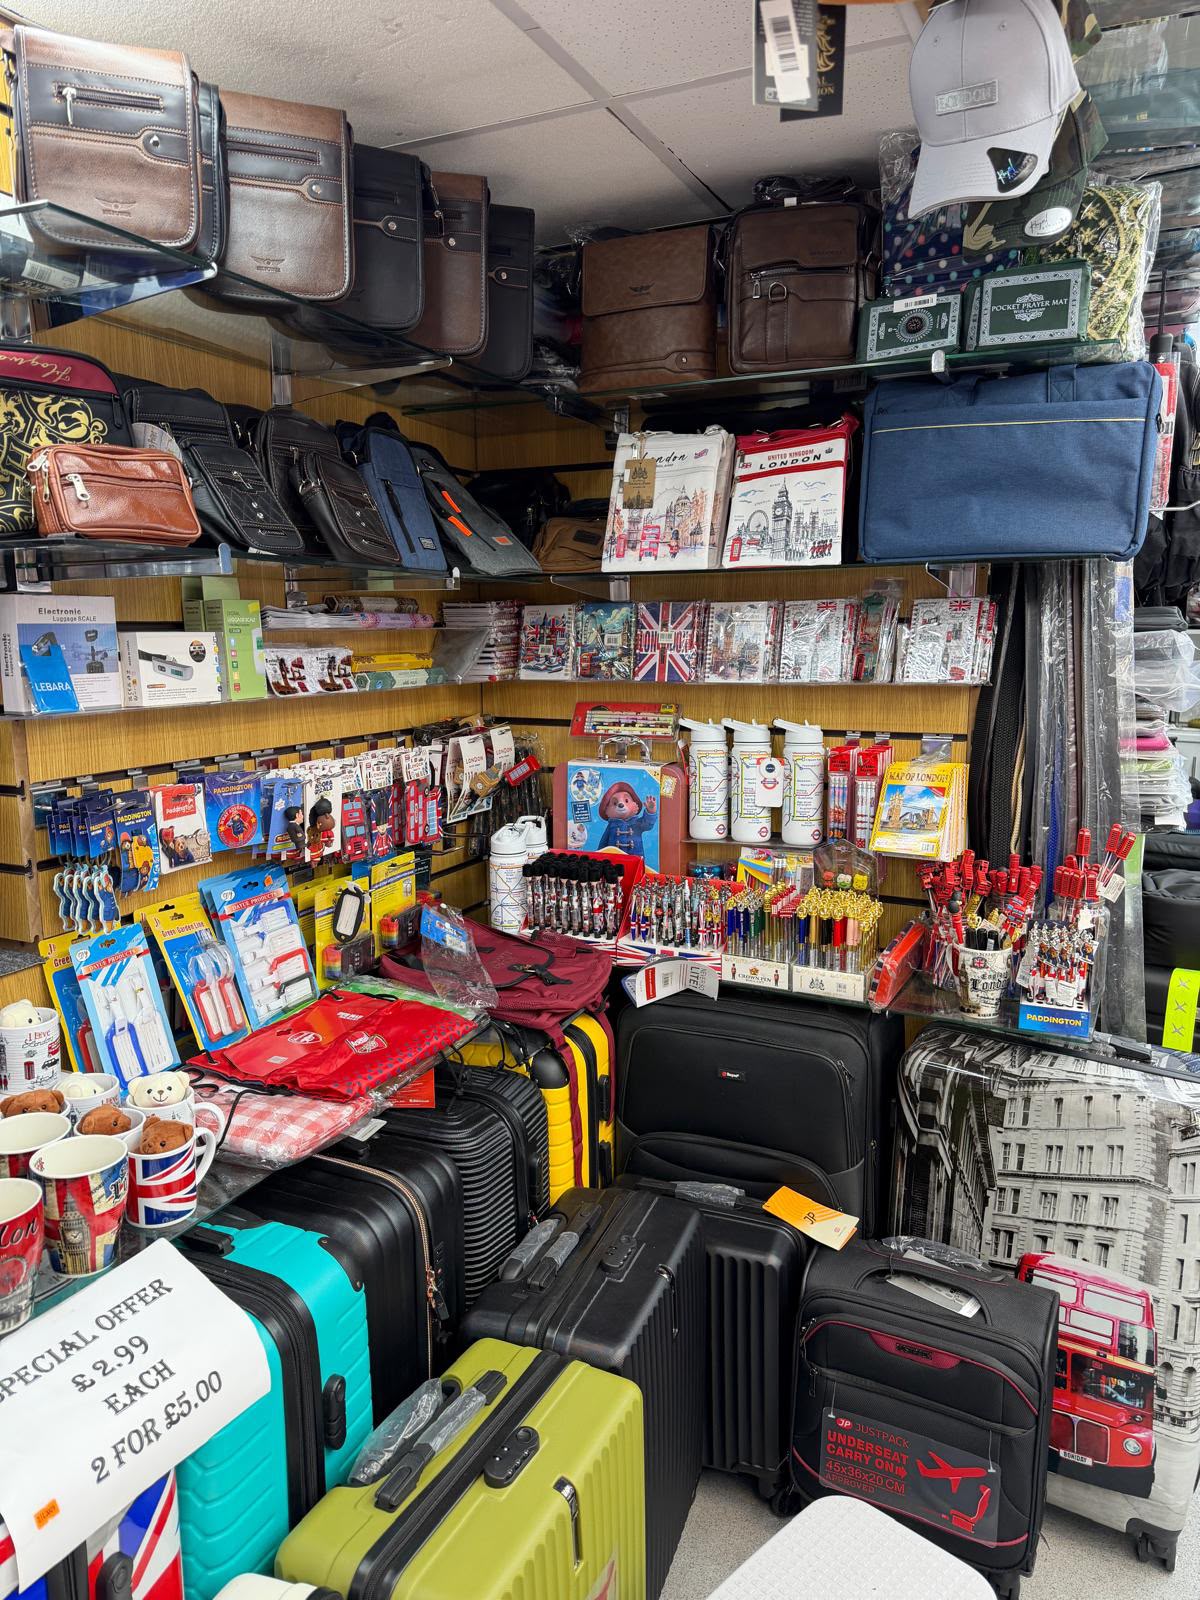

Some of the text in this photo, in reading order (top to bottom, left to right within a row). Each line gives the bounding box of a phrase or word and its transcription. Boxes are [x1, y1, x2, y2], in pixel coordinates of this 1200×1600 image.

[991, 298, 1069, 313] POCKET PRAYER MAT
[640, 452, 689, 464] Lndon
[759, 454, 822, 470] LONDON
[767, 453, 788, 461] UNITED
[38, 607, 82, 615] Electronic
[52, 615, 77, 623] Luggage
[2, 633, 10, 677] Electronic
[34, 681, 72, 692] LEBARA
[888, 772, 949, 783] MAP OF LONDON
[213, 783, 254, 795] PADDINGTON
[116, 810, 153, 823] PADDINGTON
[688, 966, 699, 989] LITE!
[1025, 1013, 1082, 1027] PADDINGTON
[803, 1211, 817, 1225] JP
[95, 1278, 174, 1331] OFFER
[71, 1335, 150, 1393] £ 2.99
[101, 1359, 177, 1416] EACH
[90, 1370, 223, 1485] 2 FOR £5.00
[837, 1418, 910, 1449] JP JUSTPACK
[826, 1429, 910, 1465] UNDERSEAT
[825, 1443, 896, 1474] CARRY ON
[824, 1473, 876, 1494] APPROVED
[825, 1460, 905, 1495] 45x36x20 CM
